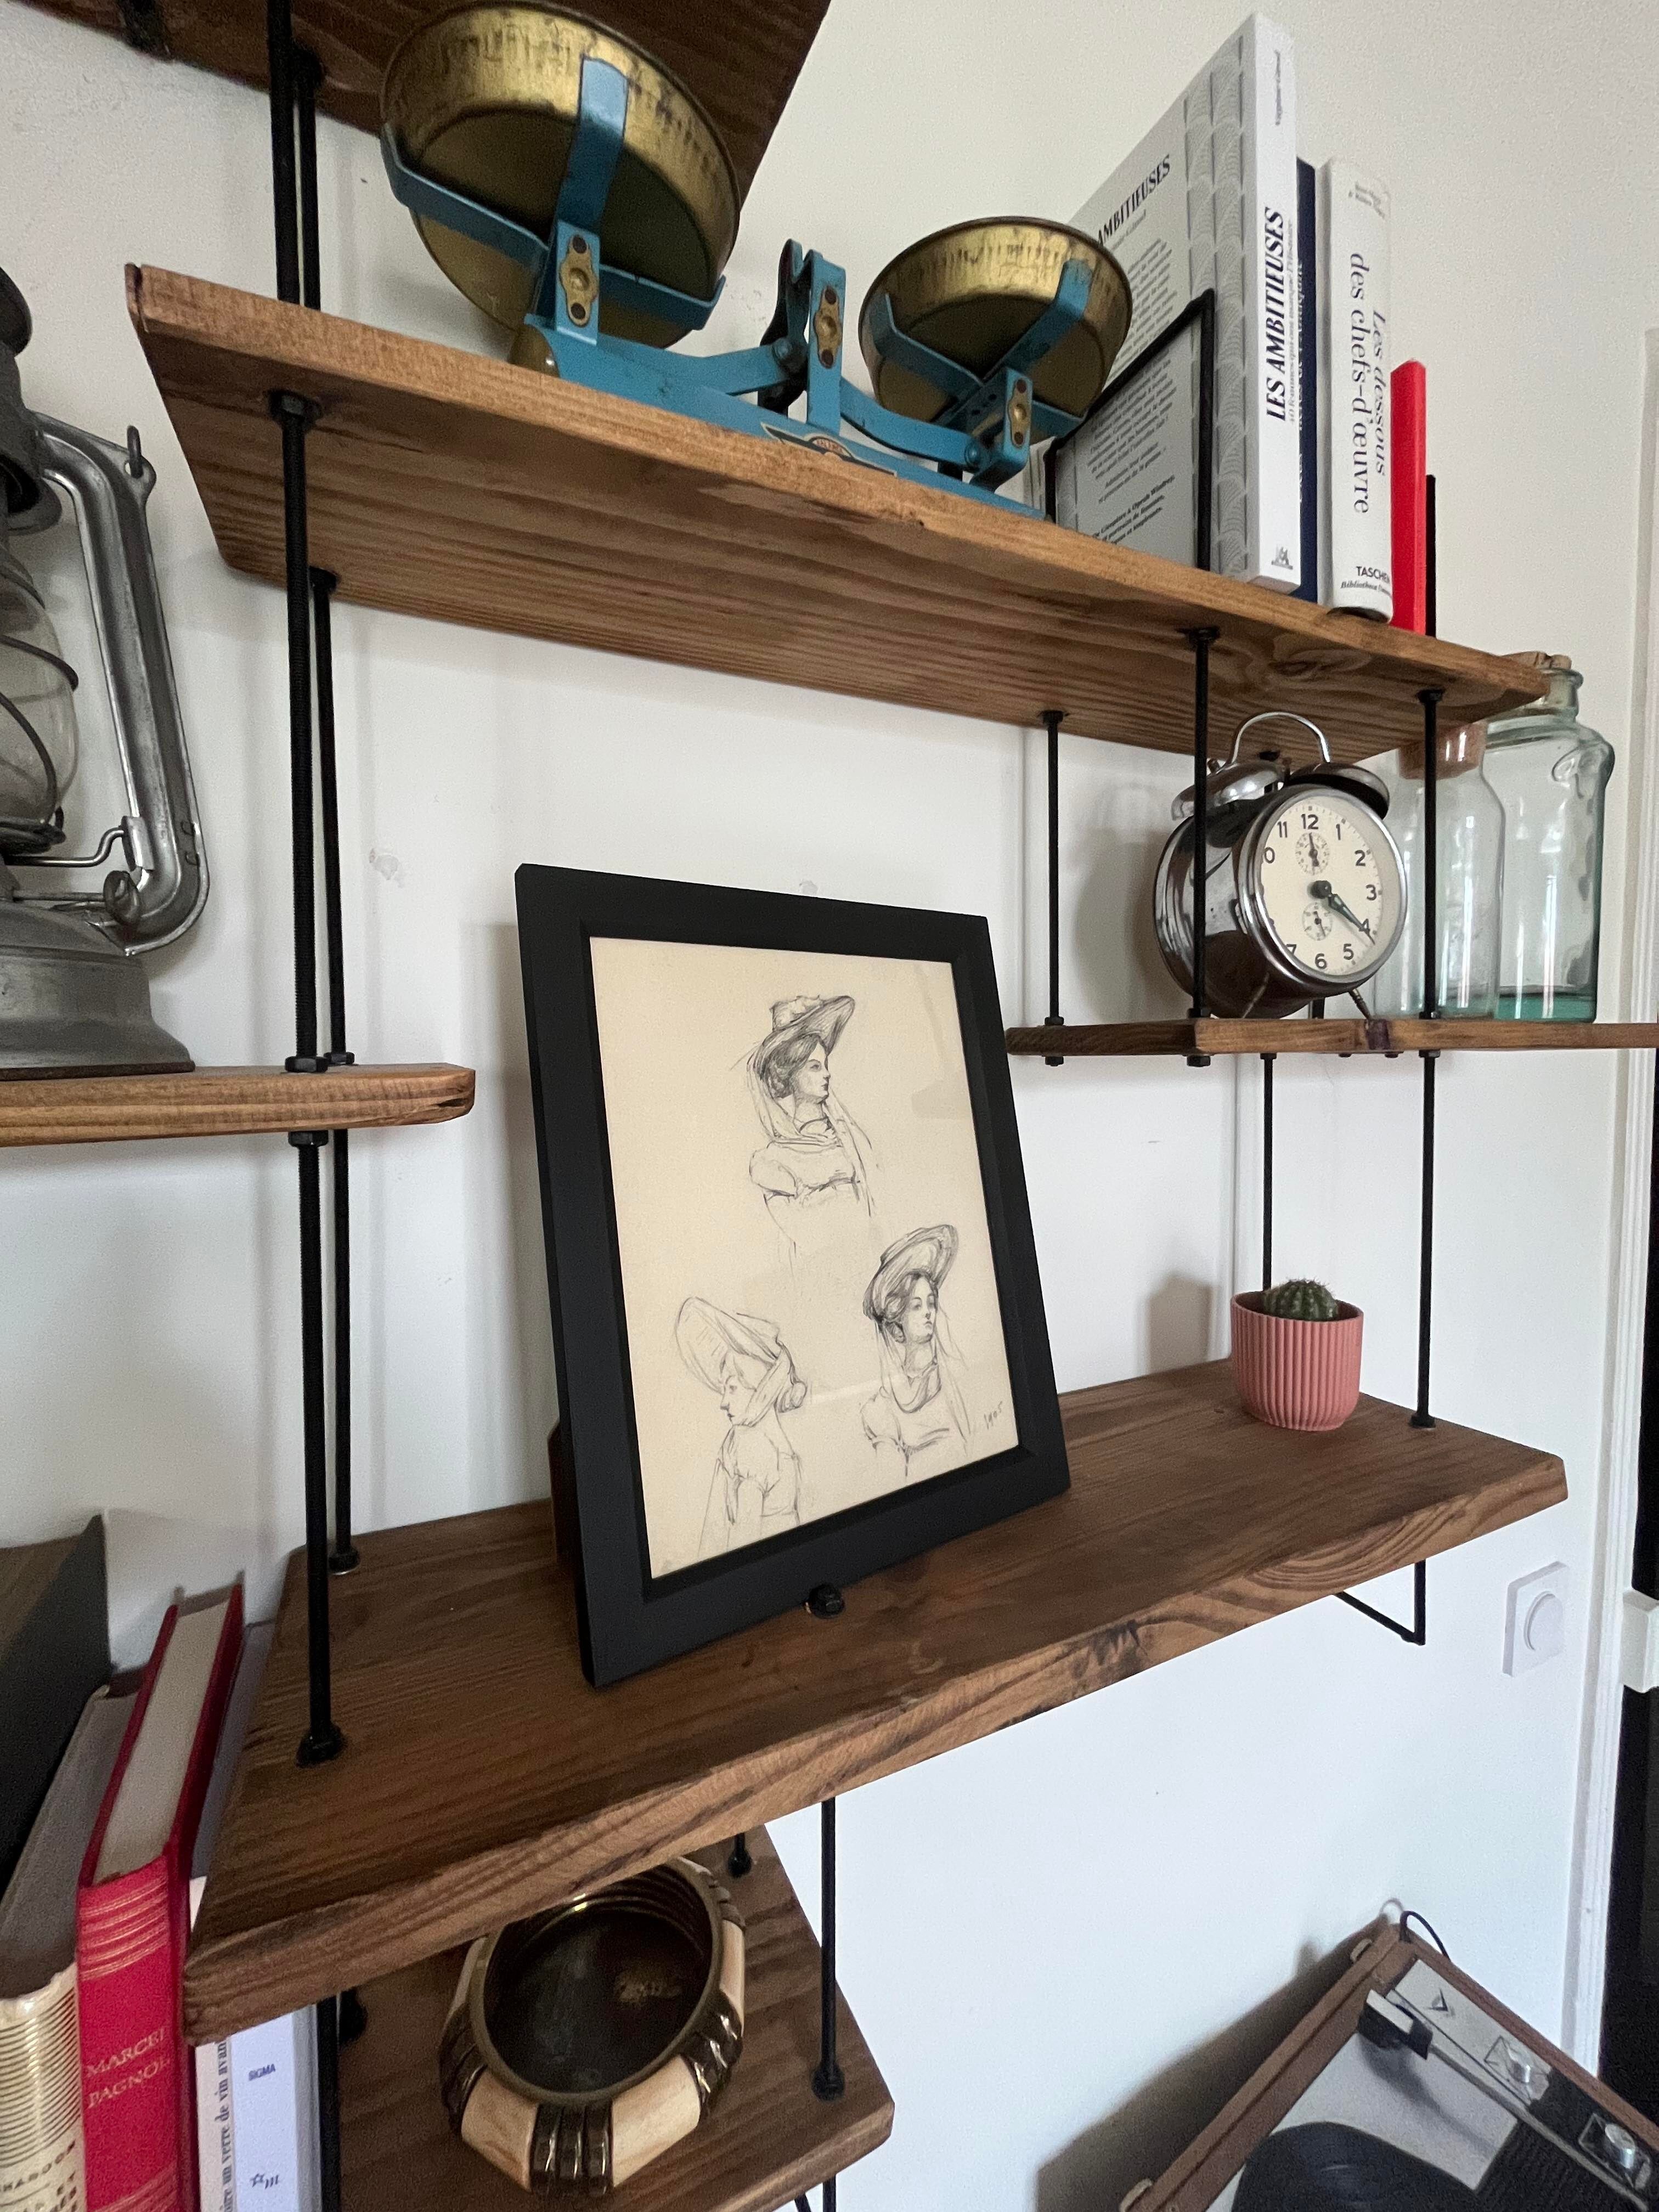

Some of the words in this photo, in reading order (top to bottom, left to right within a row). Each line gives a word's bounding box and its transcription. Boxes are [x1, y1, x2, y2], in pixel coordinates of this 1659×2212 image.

[1098, 154, 1170, 247] AMBITIEUSES
[1350, 253, 1370, 300] des
[1265, 206, 1285, 374] AMBITIEUSES
[1373, 309, 1386, 359] Les
[1266, 377, 1285, 422] LES
[1373, 365, 1386, 477] dessous
[1277, 821, 1288, 839] 11
[1301, 813, 1319, 830] 12
[1335, 823, 1342, 841] 1
[1264, 847, 1276, 865] 0
[1355, 849, 1367, 867] 2
[1365, 884, 1377, 901] 3
[1358, 918, 1371, 932] 4
[1286, 943, 1297, 956] 7
[1343, 943, 1355, 961] 5
[1314, 952, 1327, 970] 6
[217, 2041, 228, 2076] avan
[249, 2063, 276, 2081] SIGMA
[87, 2057, 171, 2109] PAGNOL
[214, 2078, 229, 2102] vin
[215, 2104, 229, 2123] de
[221, 2126, 232, 2164] verre
